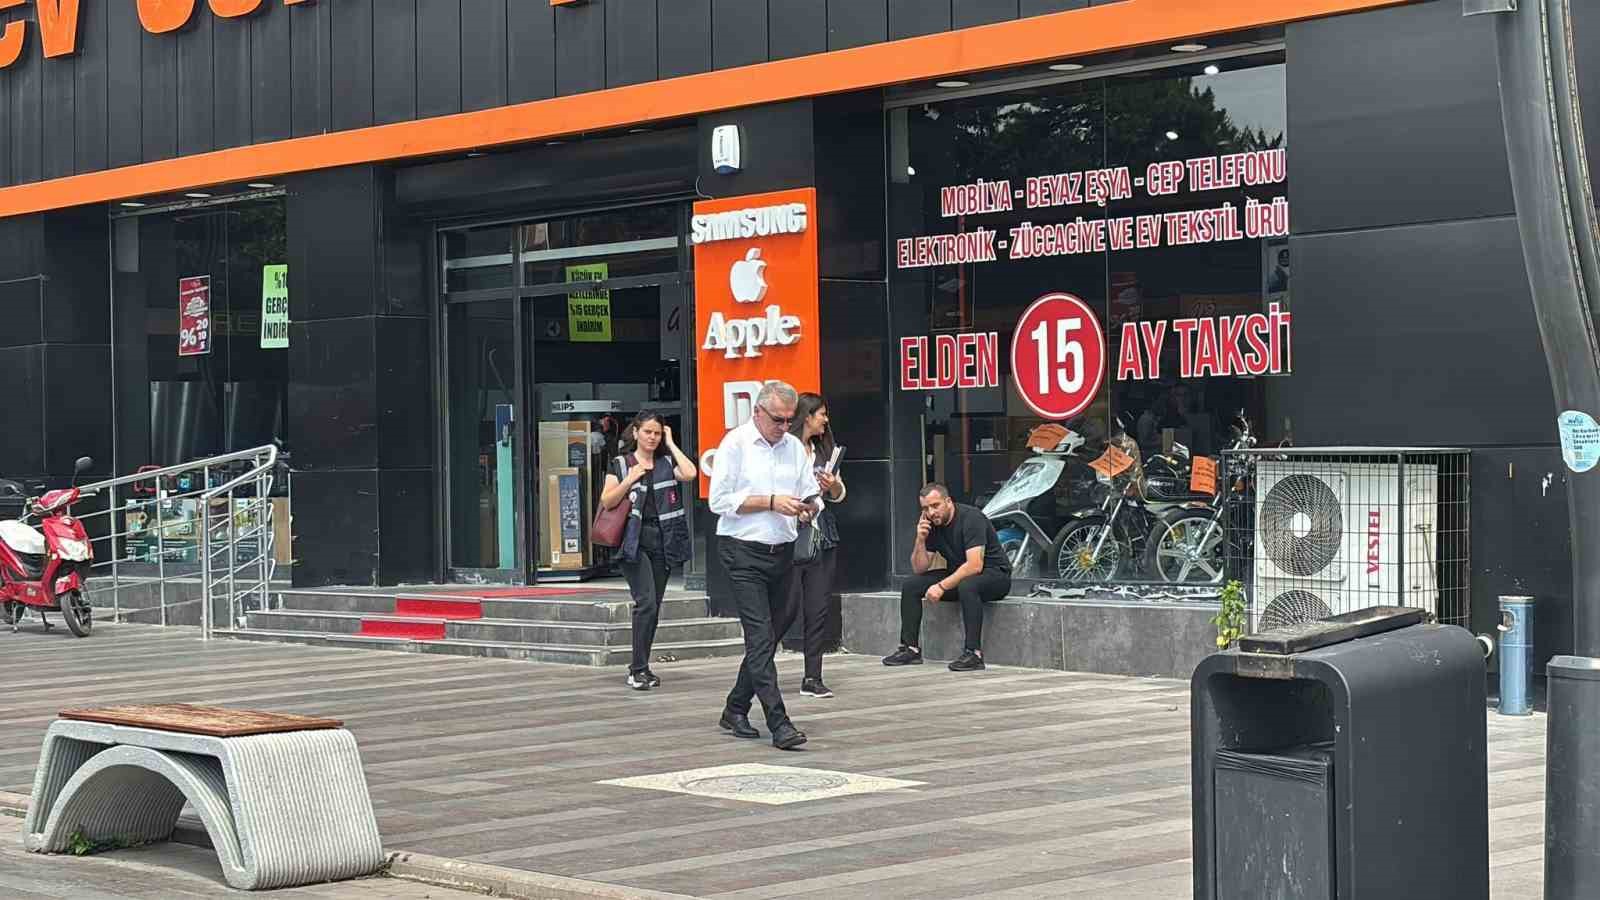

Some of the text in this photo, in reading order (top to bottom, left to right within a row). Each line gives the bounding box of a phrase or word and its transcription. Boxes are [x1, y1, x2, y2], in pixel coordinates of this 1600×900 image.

[941, 178, 1012, 217] MOBİLYA
[1026, 171, 1082, 208] BEYAZ
[1085, 166, 1132, 206] EŞYA
[1147, 161, 1184, 196] CEP
[1186, 148, 1286, 192] TELEFONU
[691, 203, 807, 244] SAMSUNG
[897, 226, 997, 269] ELEKTRONİK
[1010, 221, 1106, 259] ZÜCCACİYE
[1108, 217, 1133, 250] VE
[1136, 215, 1162, 247] EV
[1164, 202, 1243, 246] TEKSTİL
[701, 304, 801, 359] Apple
[900, 332, 999, 391] ELDEN
[1031, 317, 1085, 395] 15
[1117, 320, 1167, 381] AY
[1366, 511, 1381, 575] VESTEL
